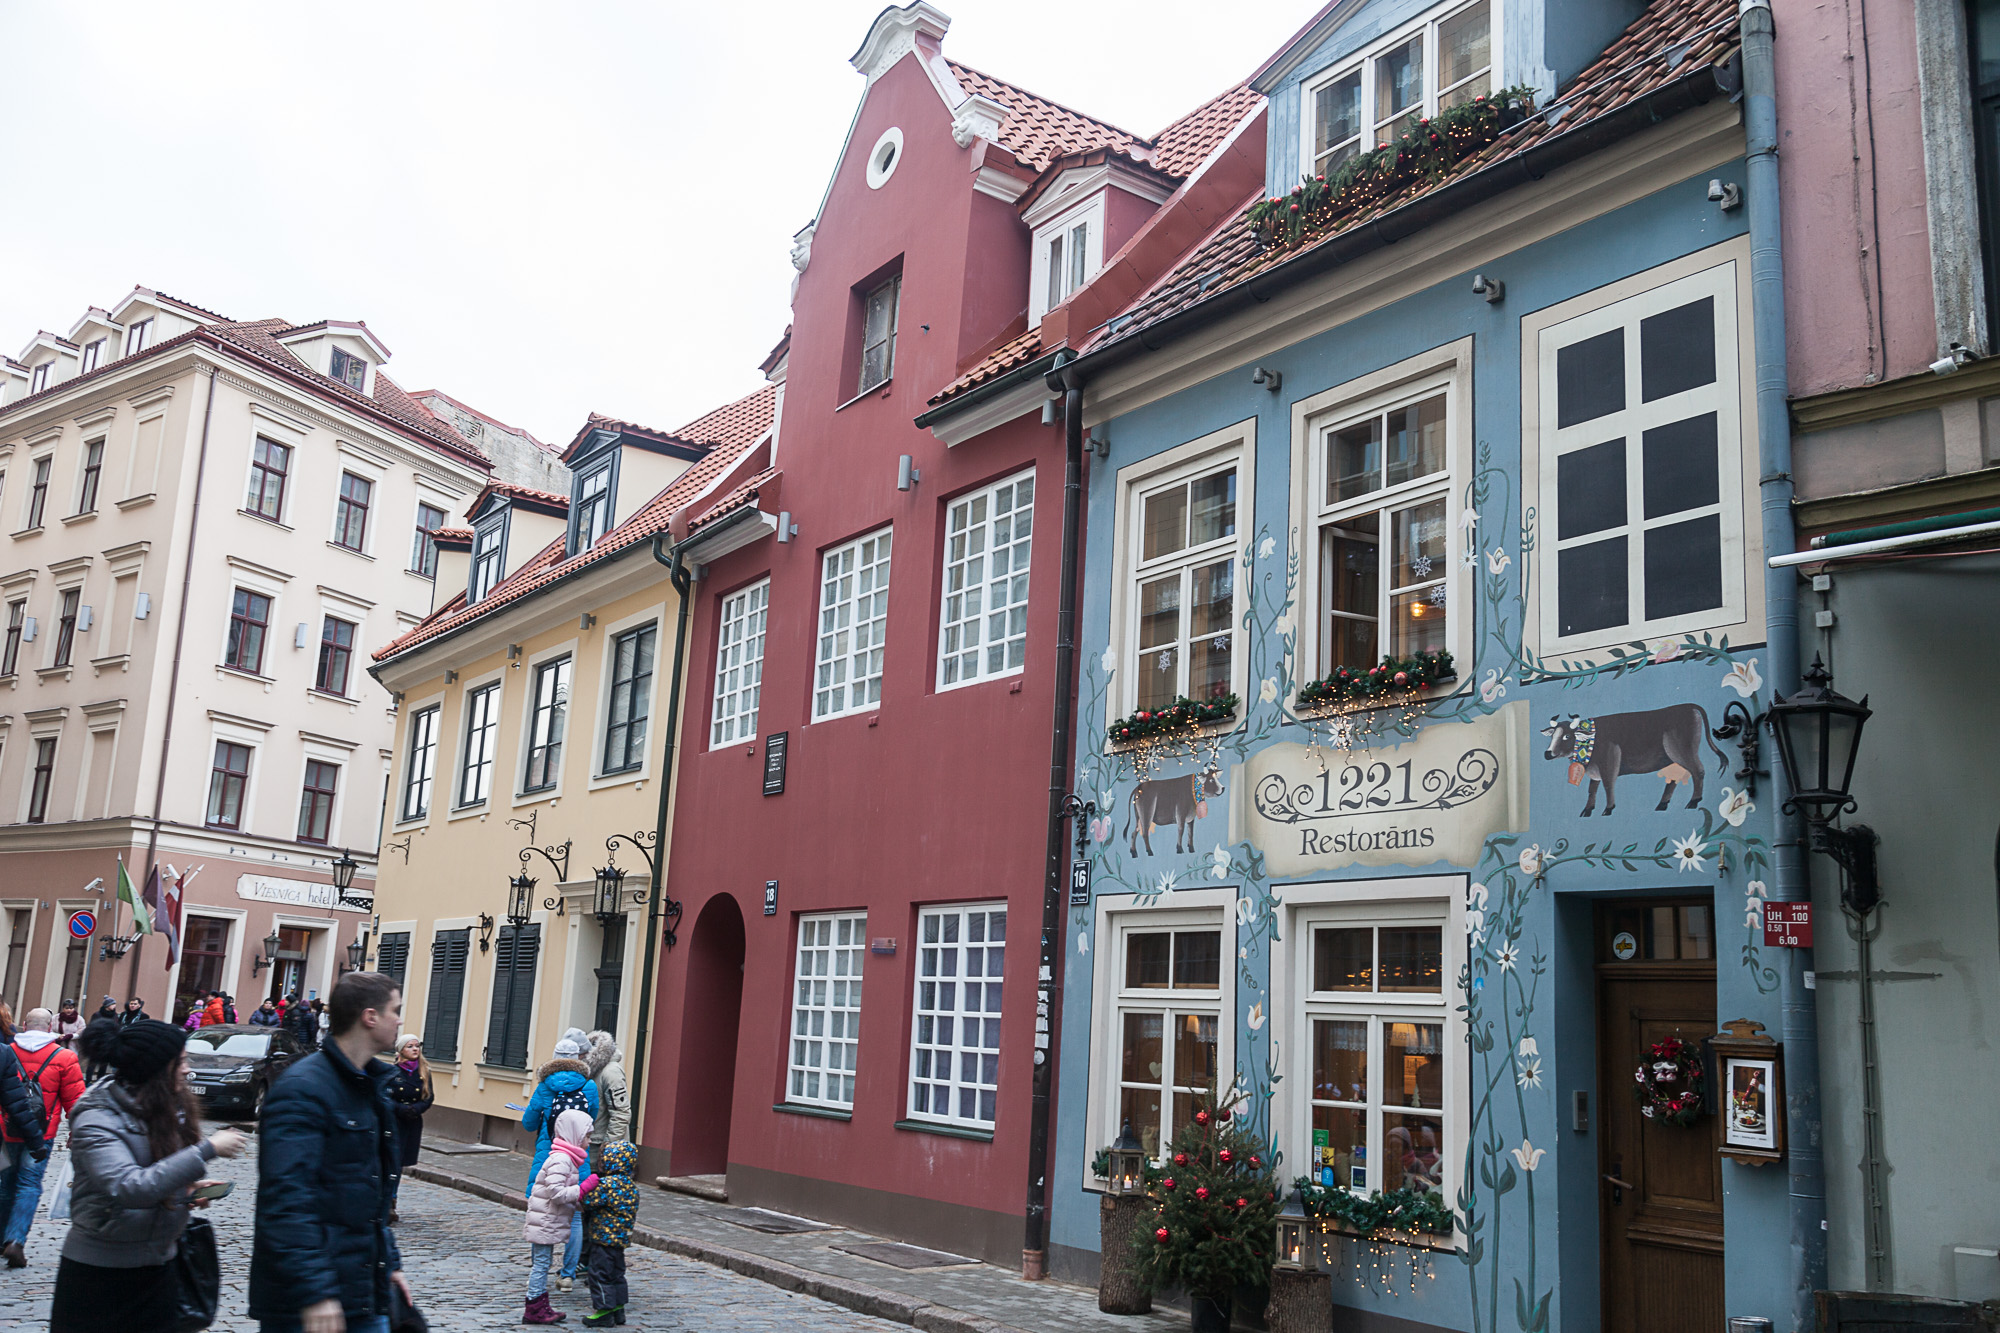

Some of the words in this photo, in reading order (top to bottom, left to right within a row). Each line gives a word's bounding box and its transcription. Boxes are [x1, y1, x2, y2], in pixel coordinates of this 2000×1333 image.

[1315, 758, 1417, 812] 1221
[1299, 826, 1435, 856] Restorāns
[1074, 869, 1086, 888] 16
[766, 888, 775, 902] 18
[1767, 911, 1782, 921] UH
[1791, 912, 1808, 921] 100
[1767, 924, 1783, 932] 0.50
[1779, 936, 1798, 945] 6.00
